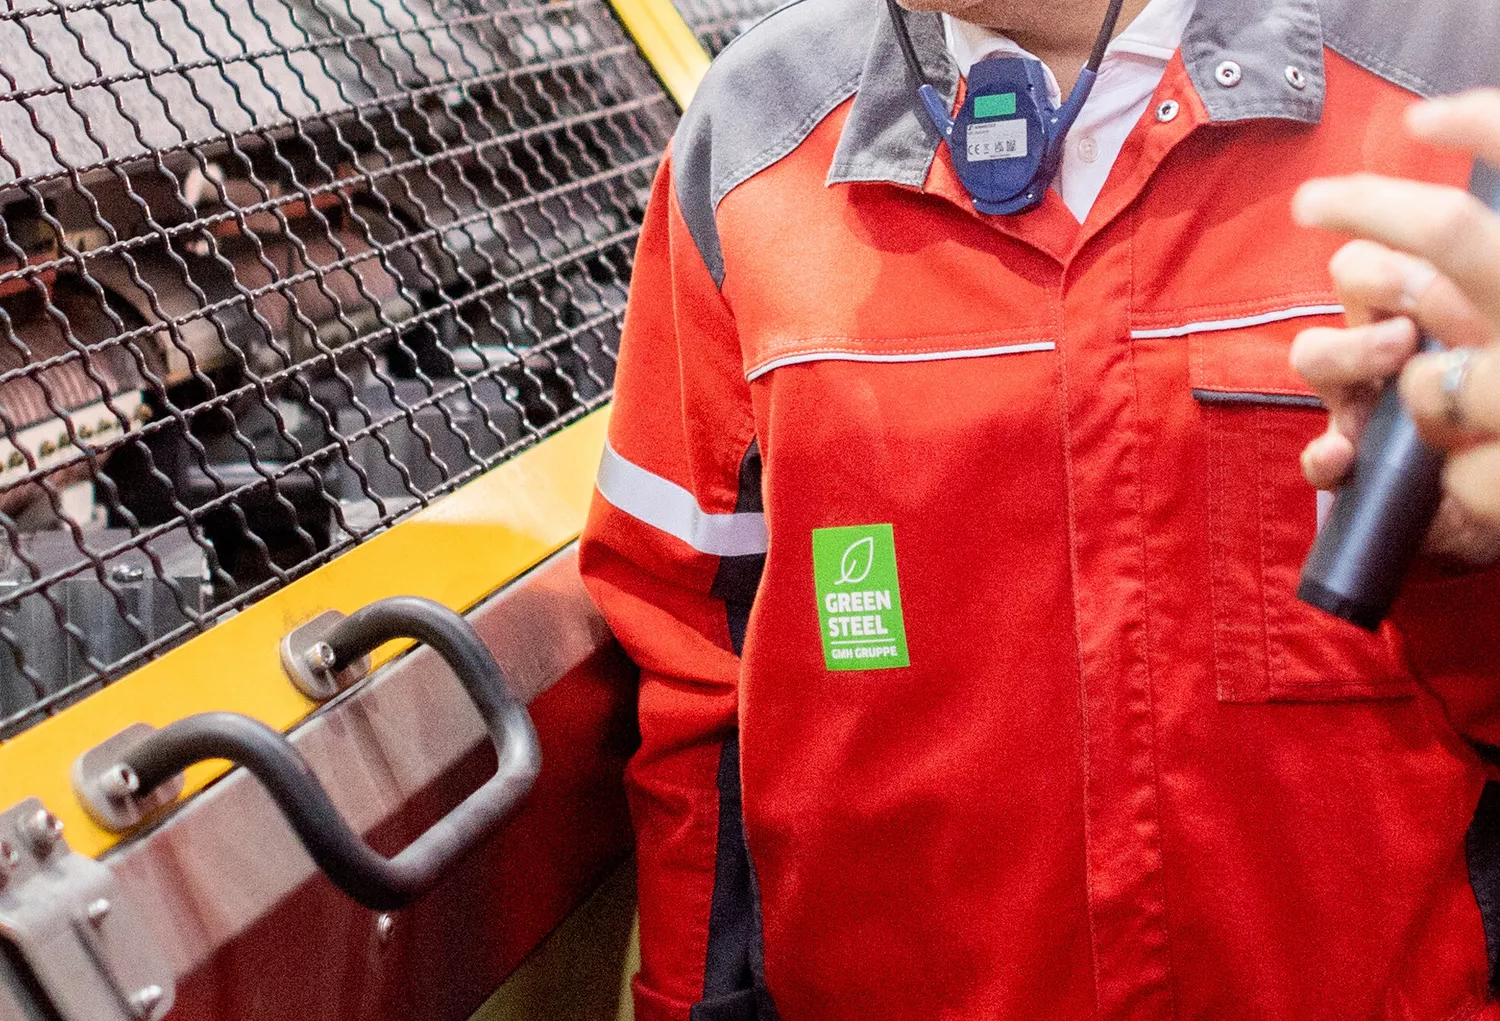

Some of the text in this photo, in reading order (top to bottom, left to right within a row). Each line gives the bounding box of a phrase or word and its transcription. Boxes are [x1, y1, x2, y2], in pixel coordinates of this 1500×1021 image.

[825, 590, 892, 613] GREEN
[828, 614, 889, 637] STEEL
[831, 646, 898, 659] GMH GRUPPE
